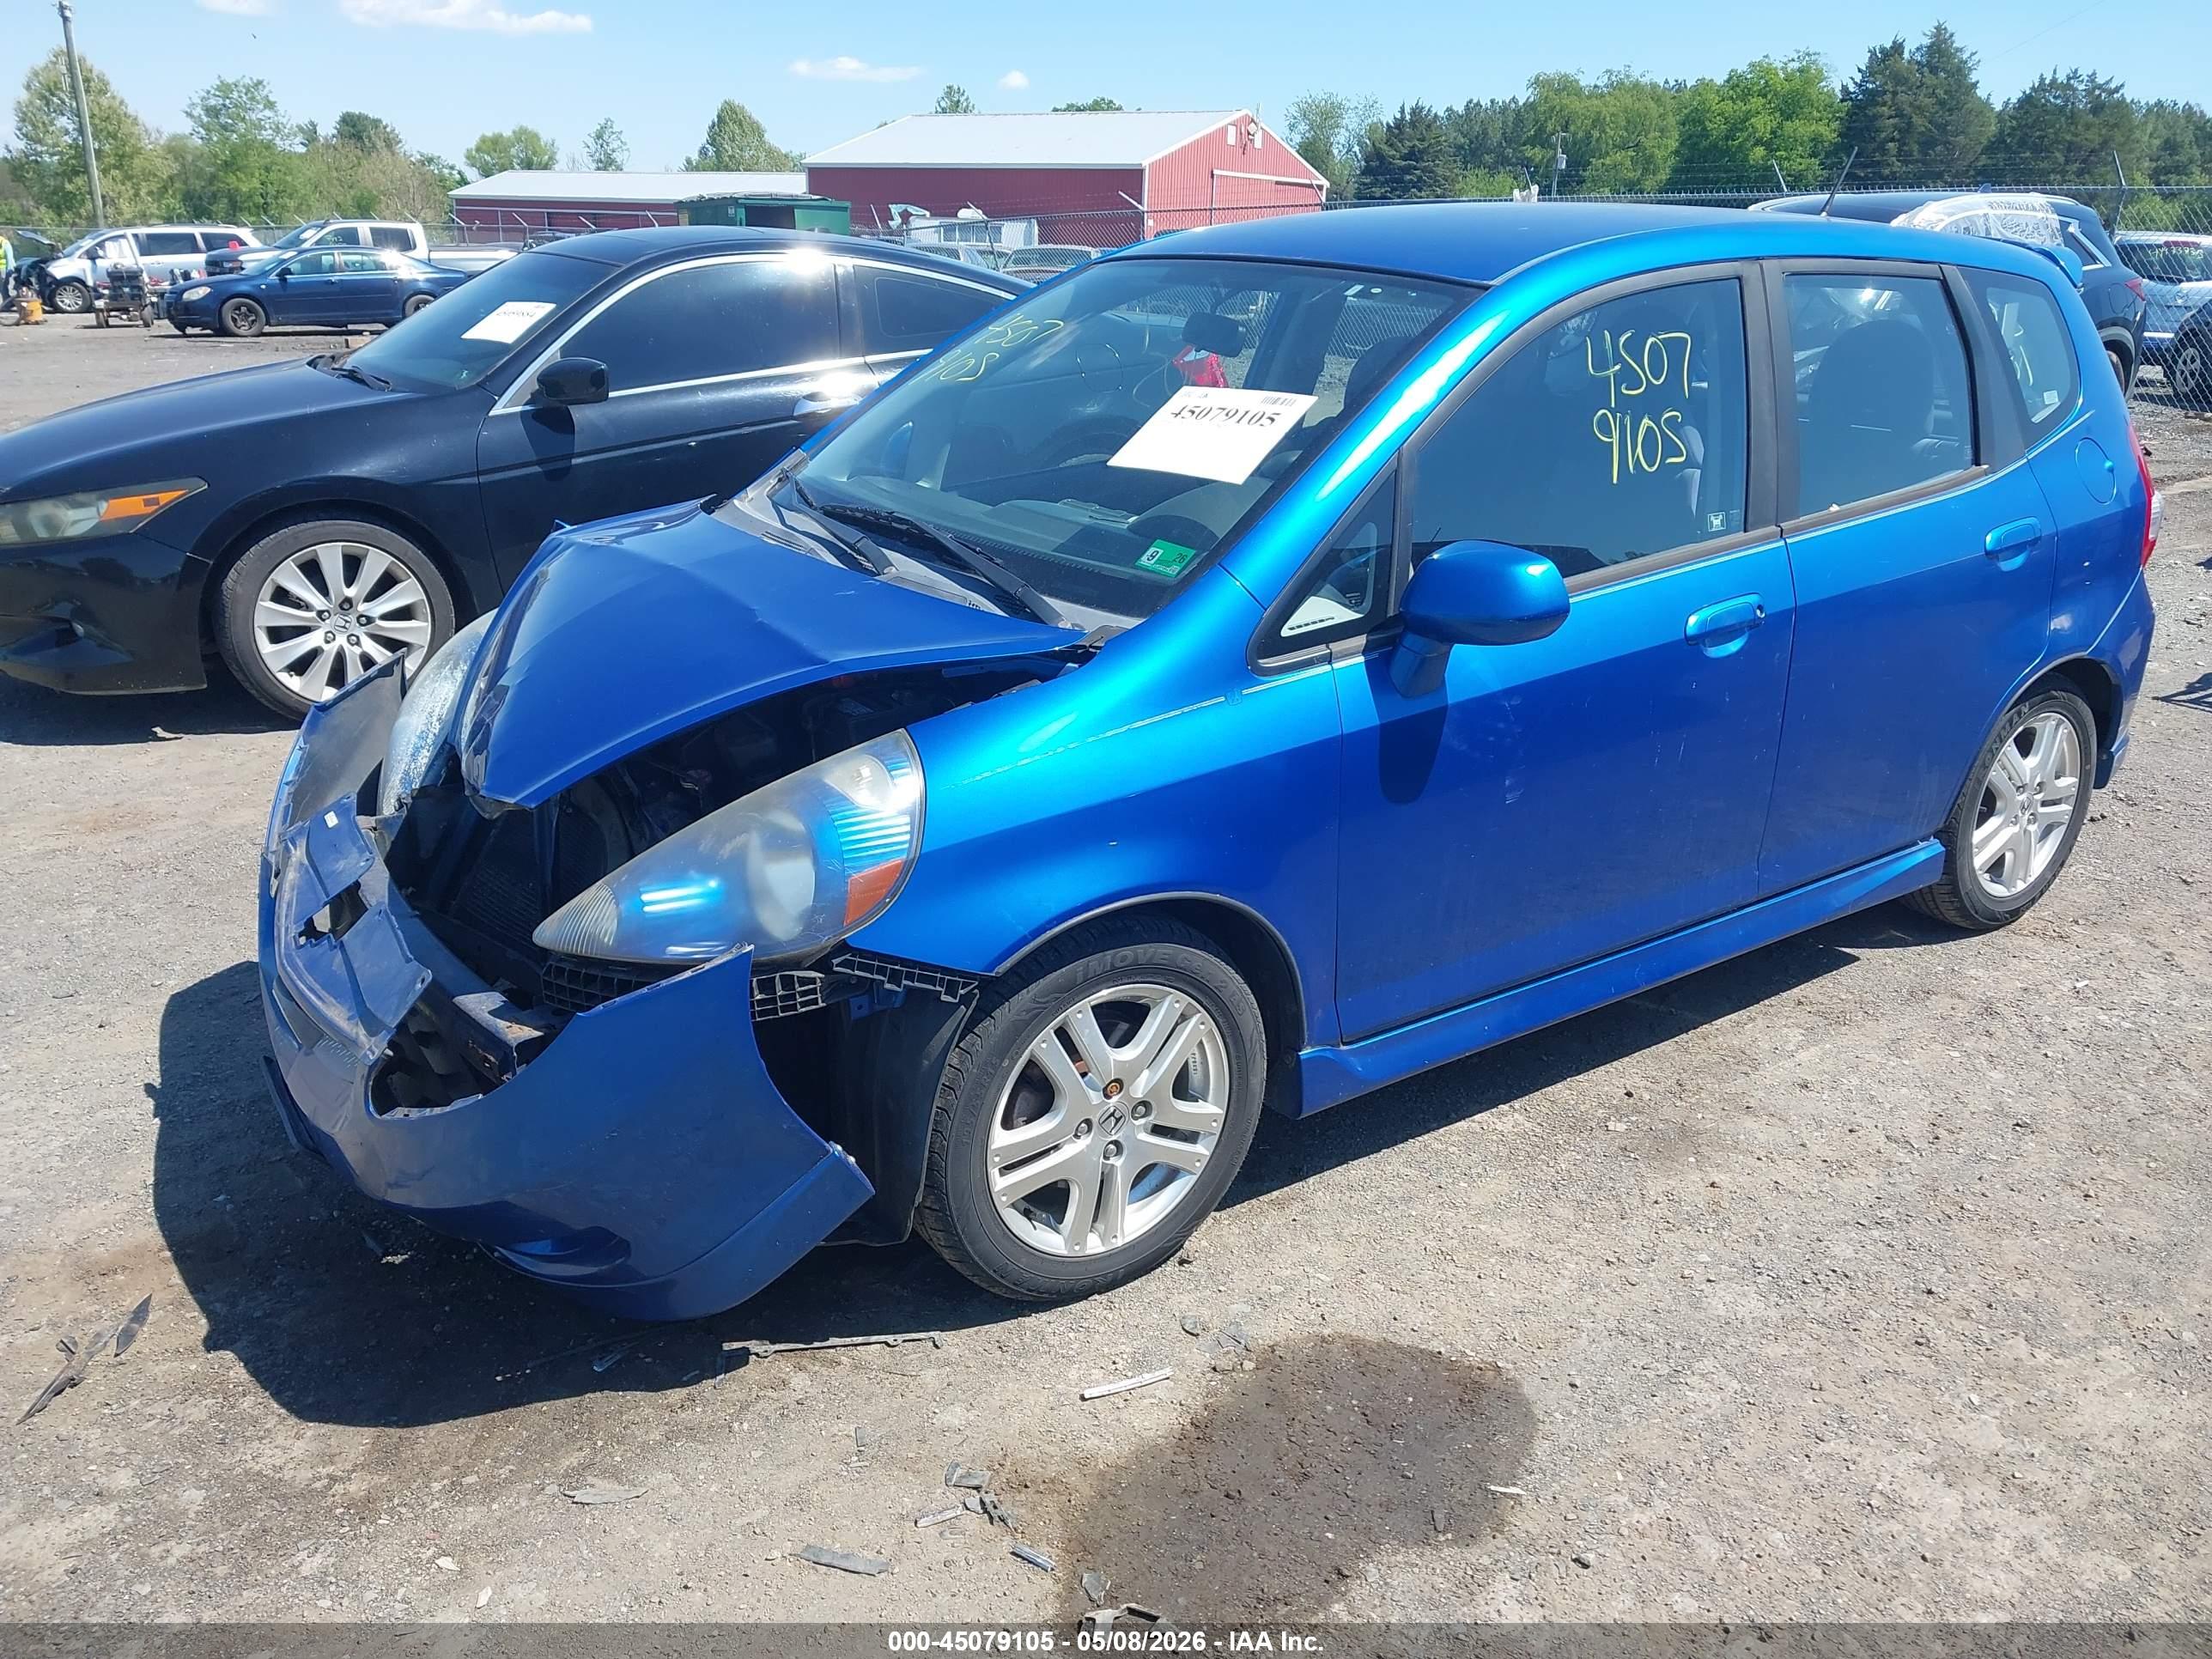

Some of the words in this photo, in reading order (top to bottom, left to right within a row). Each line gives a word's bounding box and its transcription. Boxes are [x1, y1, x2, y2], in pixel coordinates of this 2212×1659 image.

[975, 313, 1064, 347] 4507
[908, 349, 1000, 386] 9105
[1586, 330, 1692, 408] 4507
[1170, 404, 1282, 427] 45079105
[1592, 407, 1688, 484] 9105
[1173, 552, 1188, 564] 26
[1075, 949, 1174, 985] iMOVE
